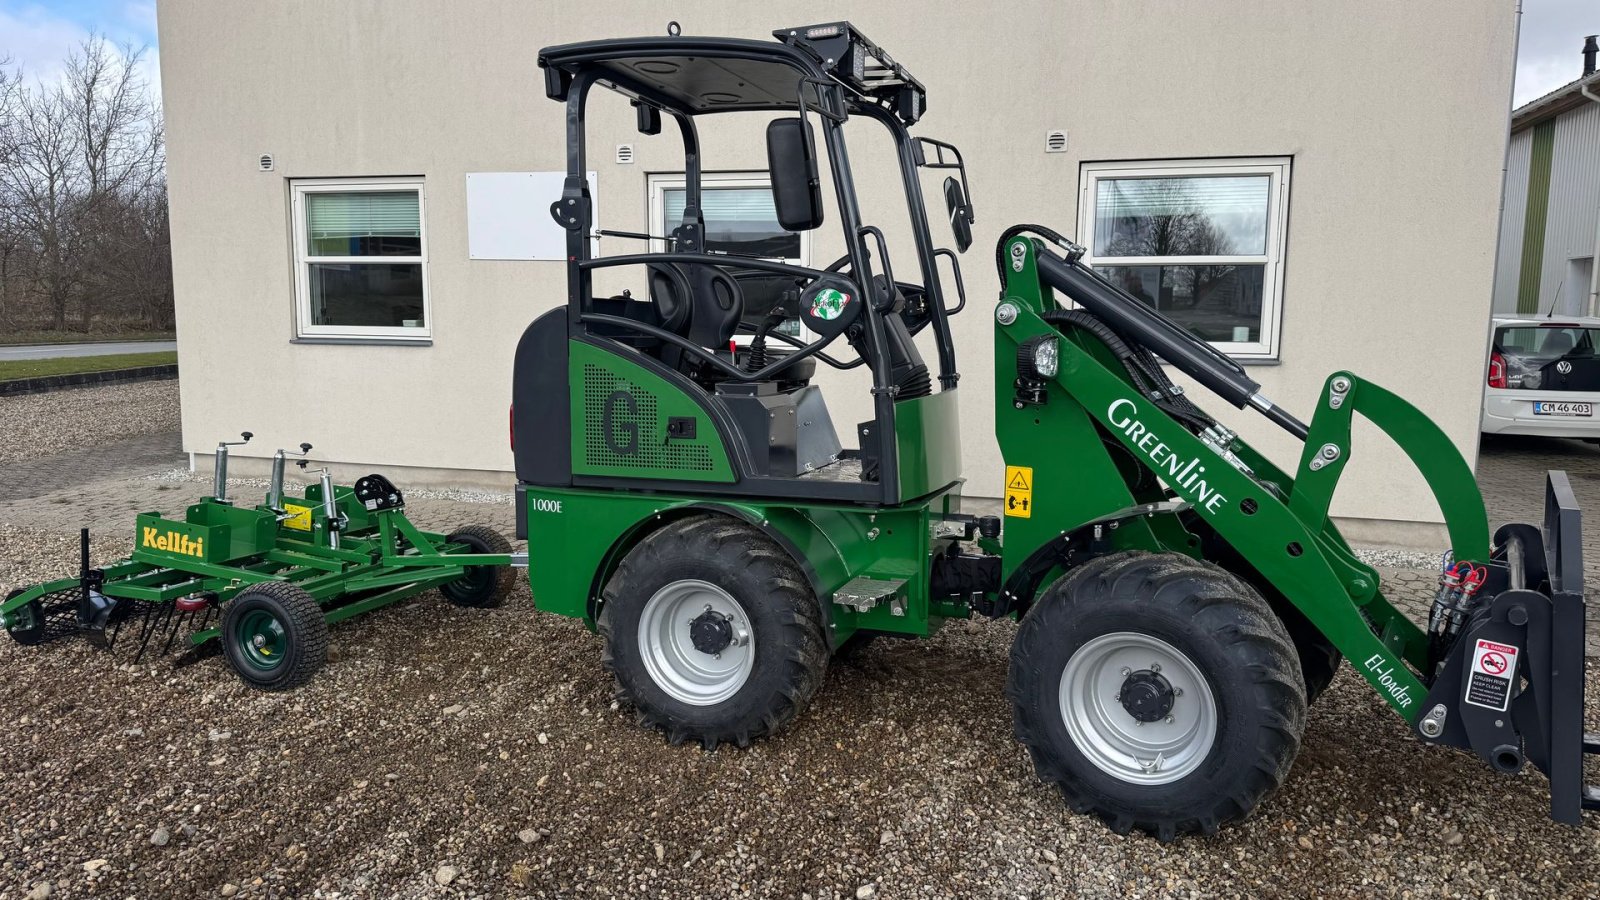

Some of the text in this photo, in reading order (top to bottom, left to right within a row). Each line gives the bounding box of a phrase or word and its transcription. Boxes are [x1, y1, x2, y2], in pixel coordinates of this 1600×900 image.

[1541, 403, 1590, 413] CM 46 403
[603, 390, 639, 457] G
[532, 498, 563, 513] 1000E
[143, 526, 203, 558] Kellfri
